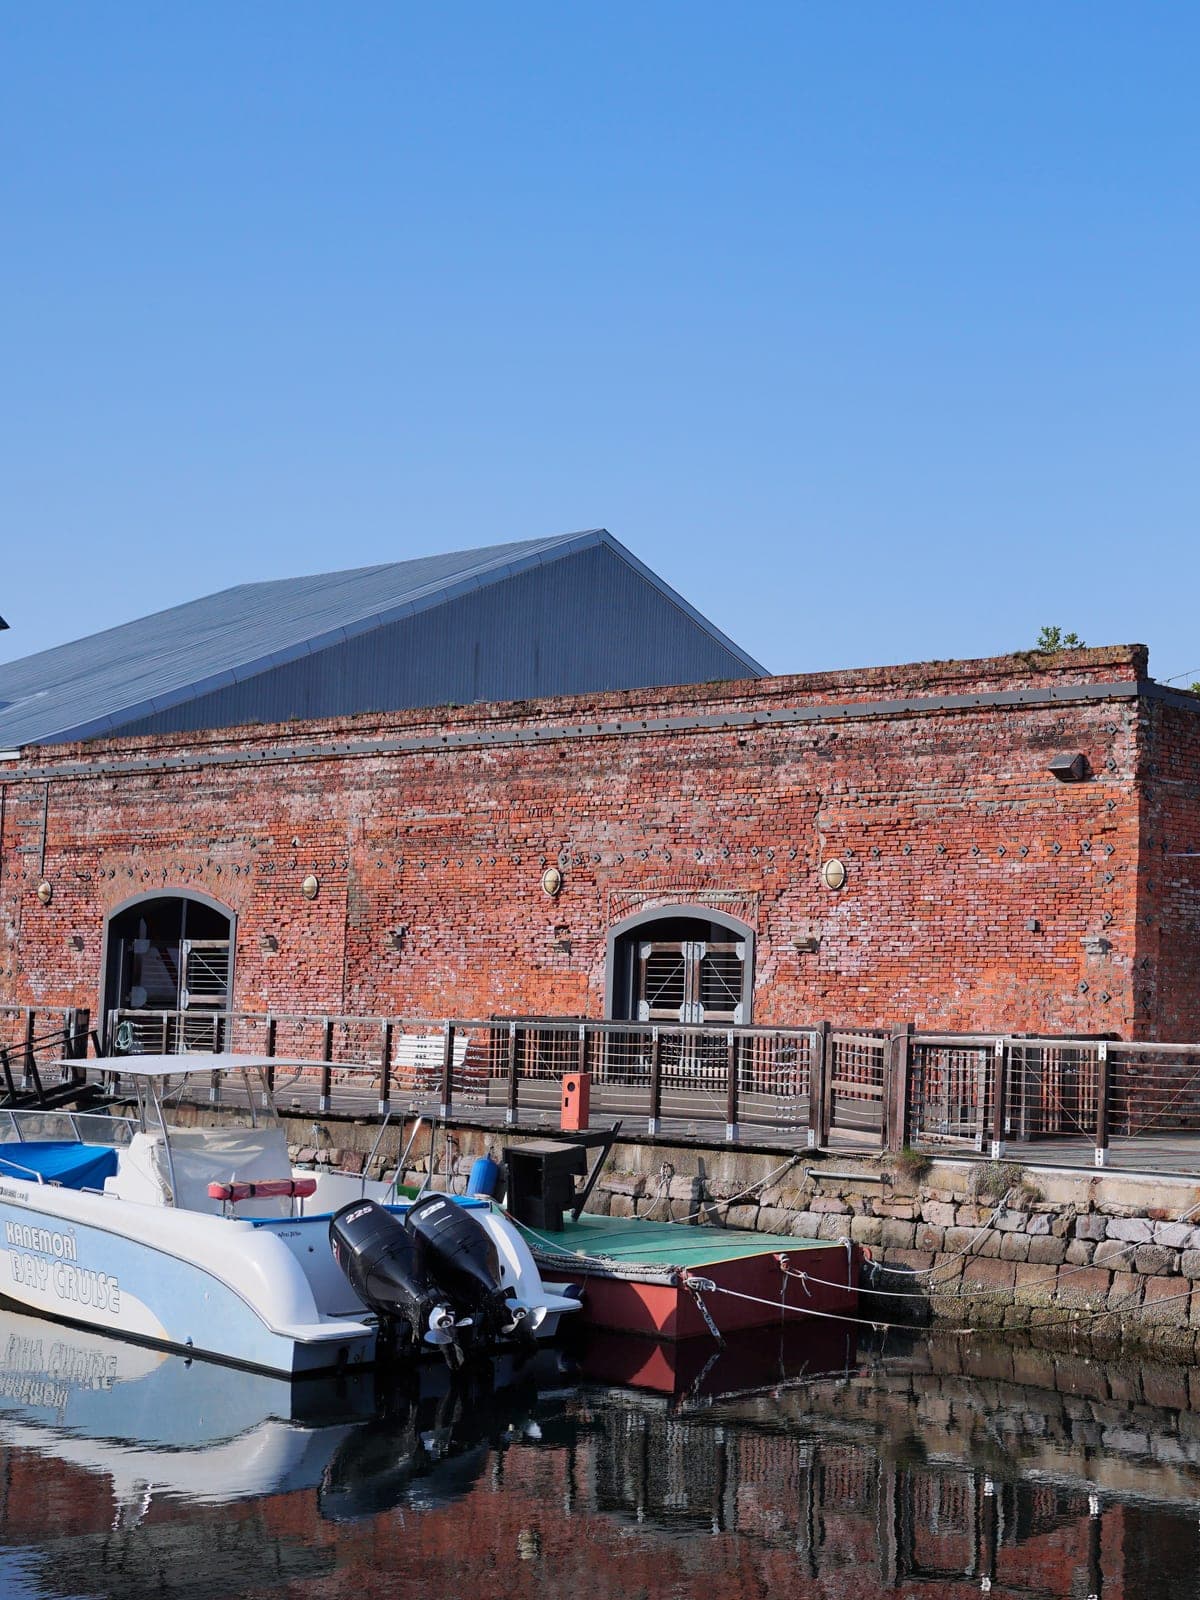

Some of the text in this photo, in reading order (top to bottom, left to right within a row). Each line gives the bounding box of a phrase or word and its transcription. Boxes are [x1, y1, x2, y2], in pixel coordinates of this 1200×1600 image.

[345, 1205, 374, 1225] 225
[419, 1200, 447, 1220] 225
[5, 1220, 78, 1262] KANEMORI
[8, 1247, 121, 1314] BAY CRUISE
